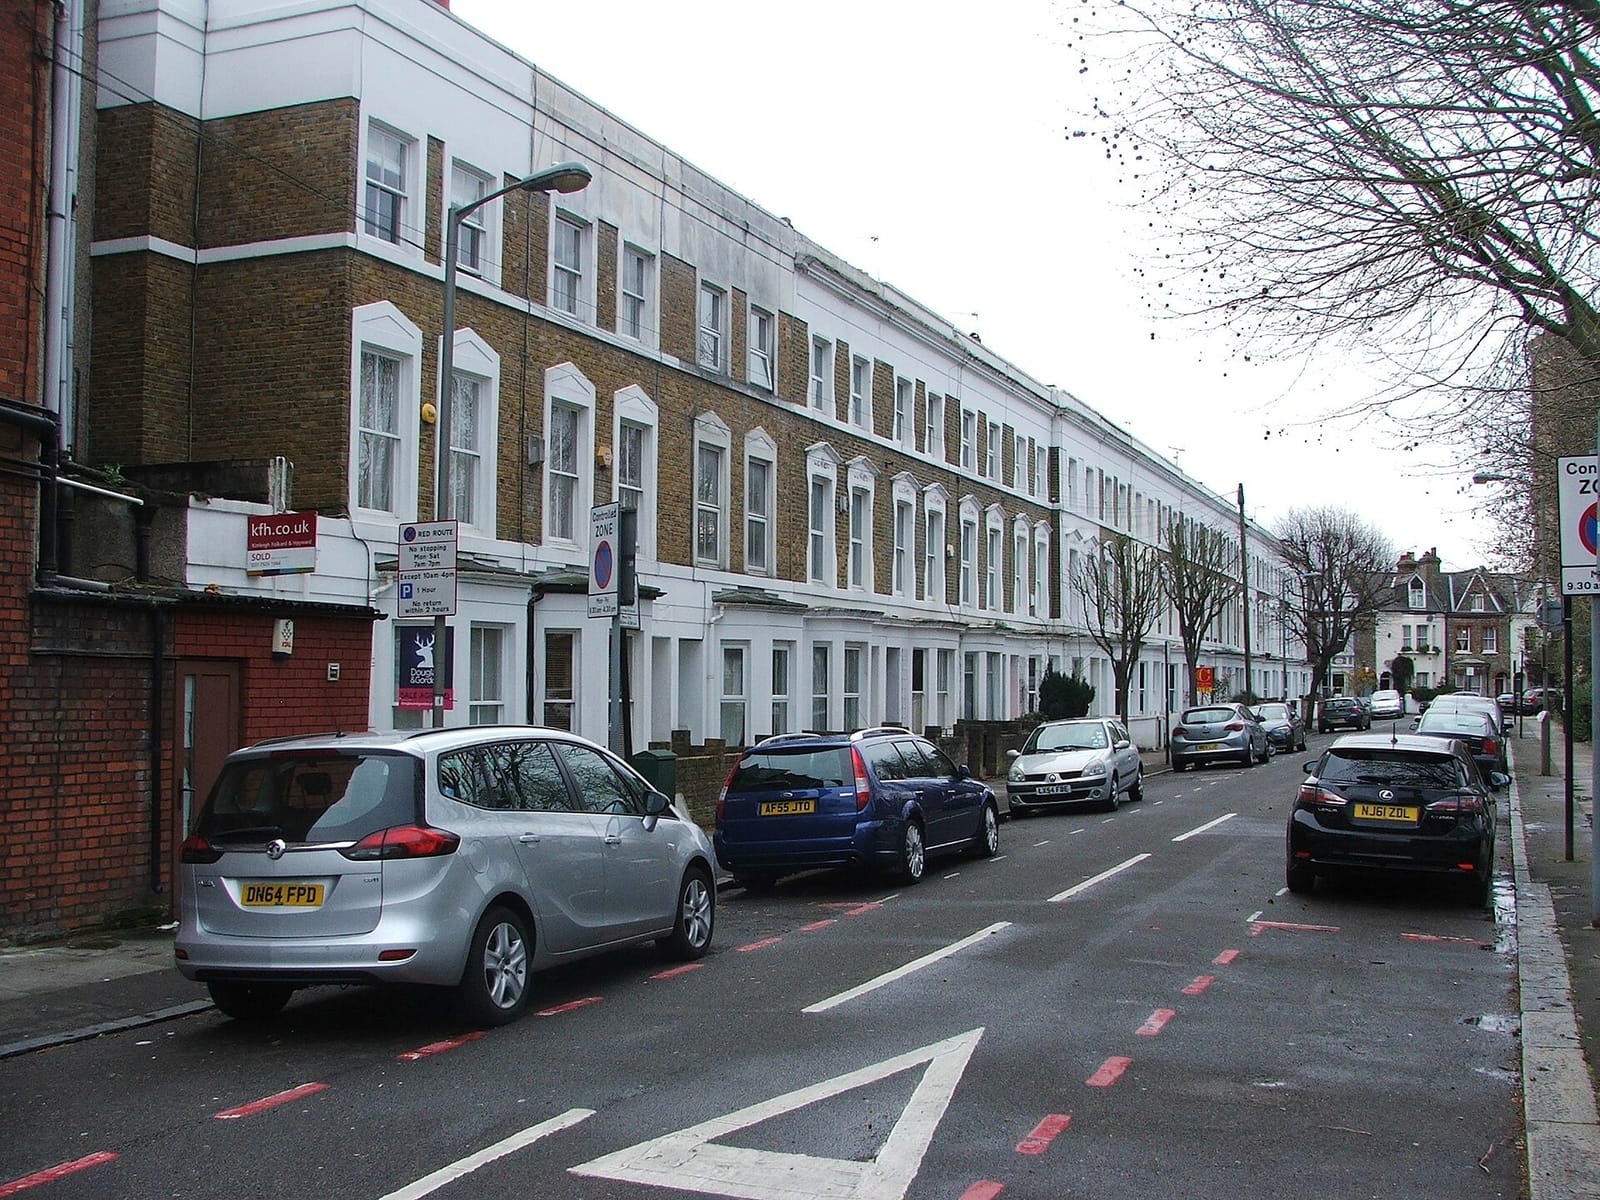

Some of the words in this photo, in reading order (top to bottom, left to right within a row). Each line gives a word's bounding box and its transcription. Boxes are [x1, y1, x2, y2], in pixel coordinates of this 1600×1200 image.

[592, 510, 617, 522] Controlled
[251, 520, 309, 537] kfh.co.uk
[595, 523, 613, 537] ZONE
[251, 553, 271, 561] SOLD
[402, 585, 411, 598] P
[1567, 582, 1591, 590] 9.30
[410, 668, 434, 677] Dougl
[765, 802, 789, 812] AF55
[791, 801, 810, 811] JTO
[1361, 805, 1386, 817] NJ61
[1388, 807, 1410, 819] ZDL
[247, 886, 283, 903] DN64
[287, 885, 317, 903] FPD
